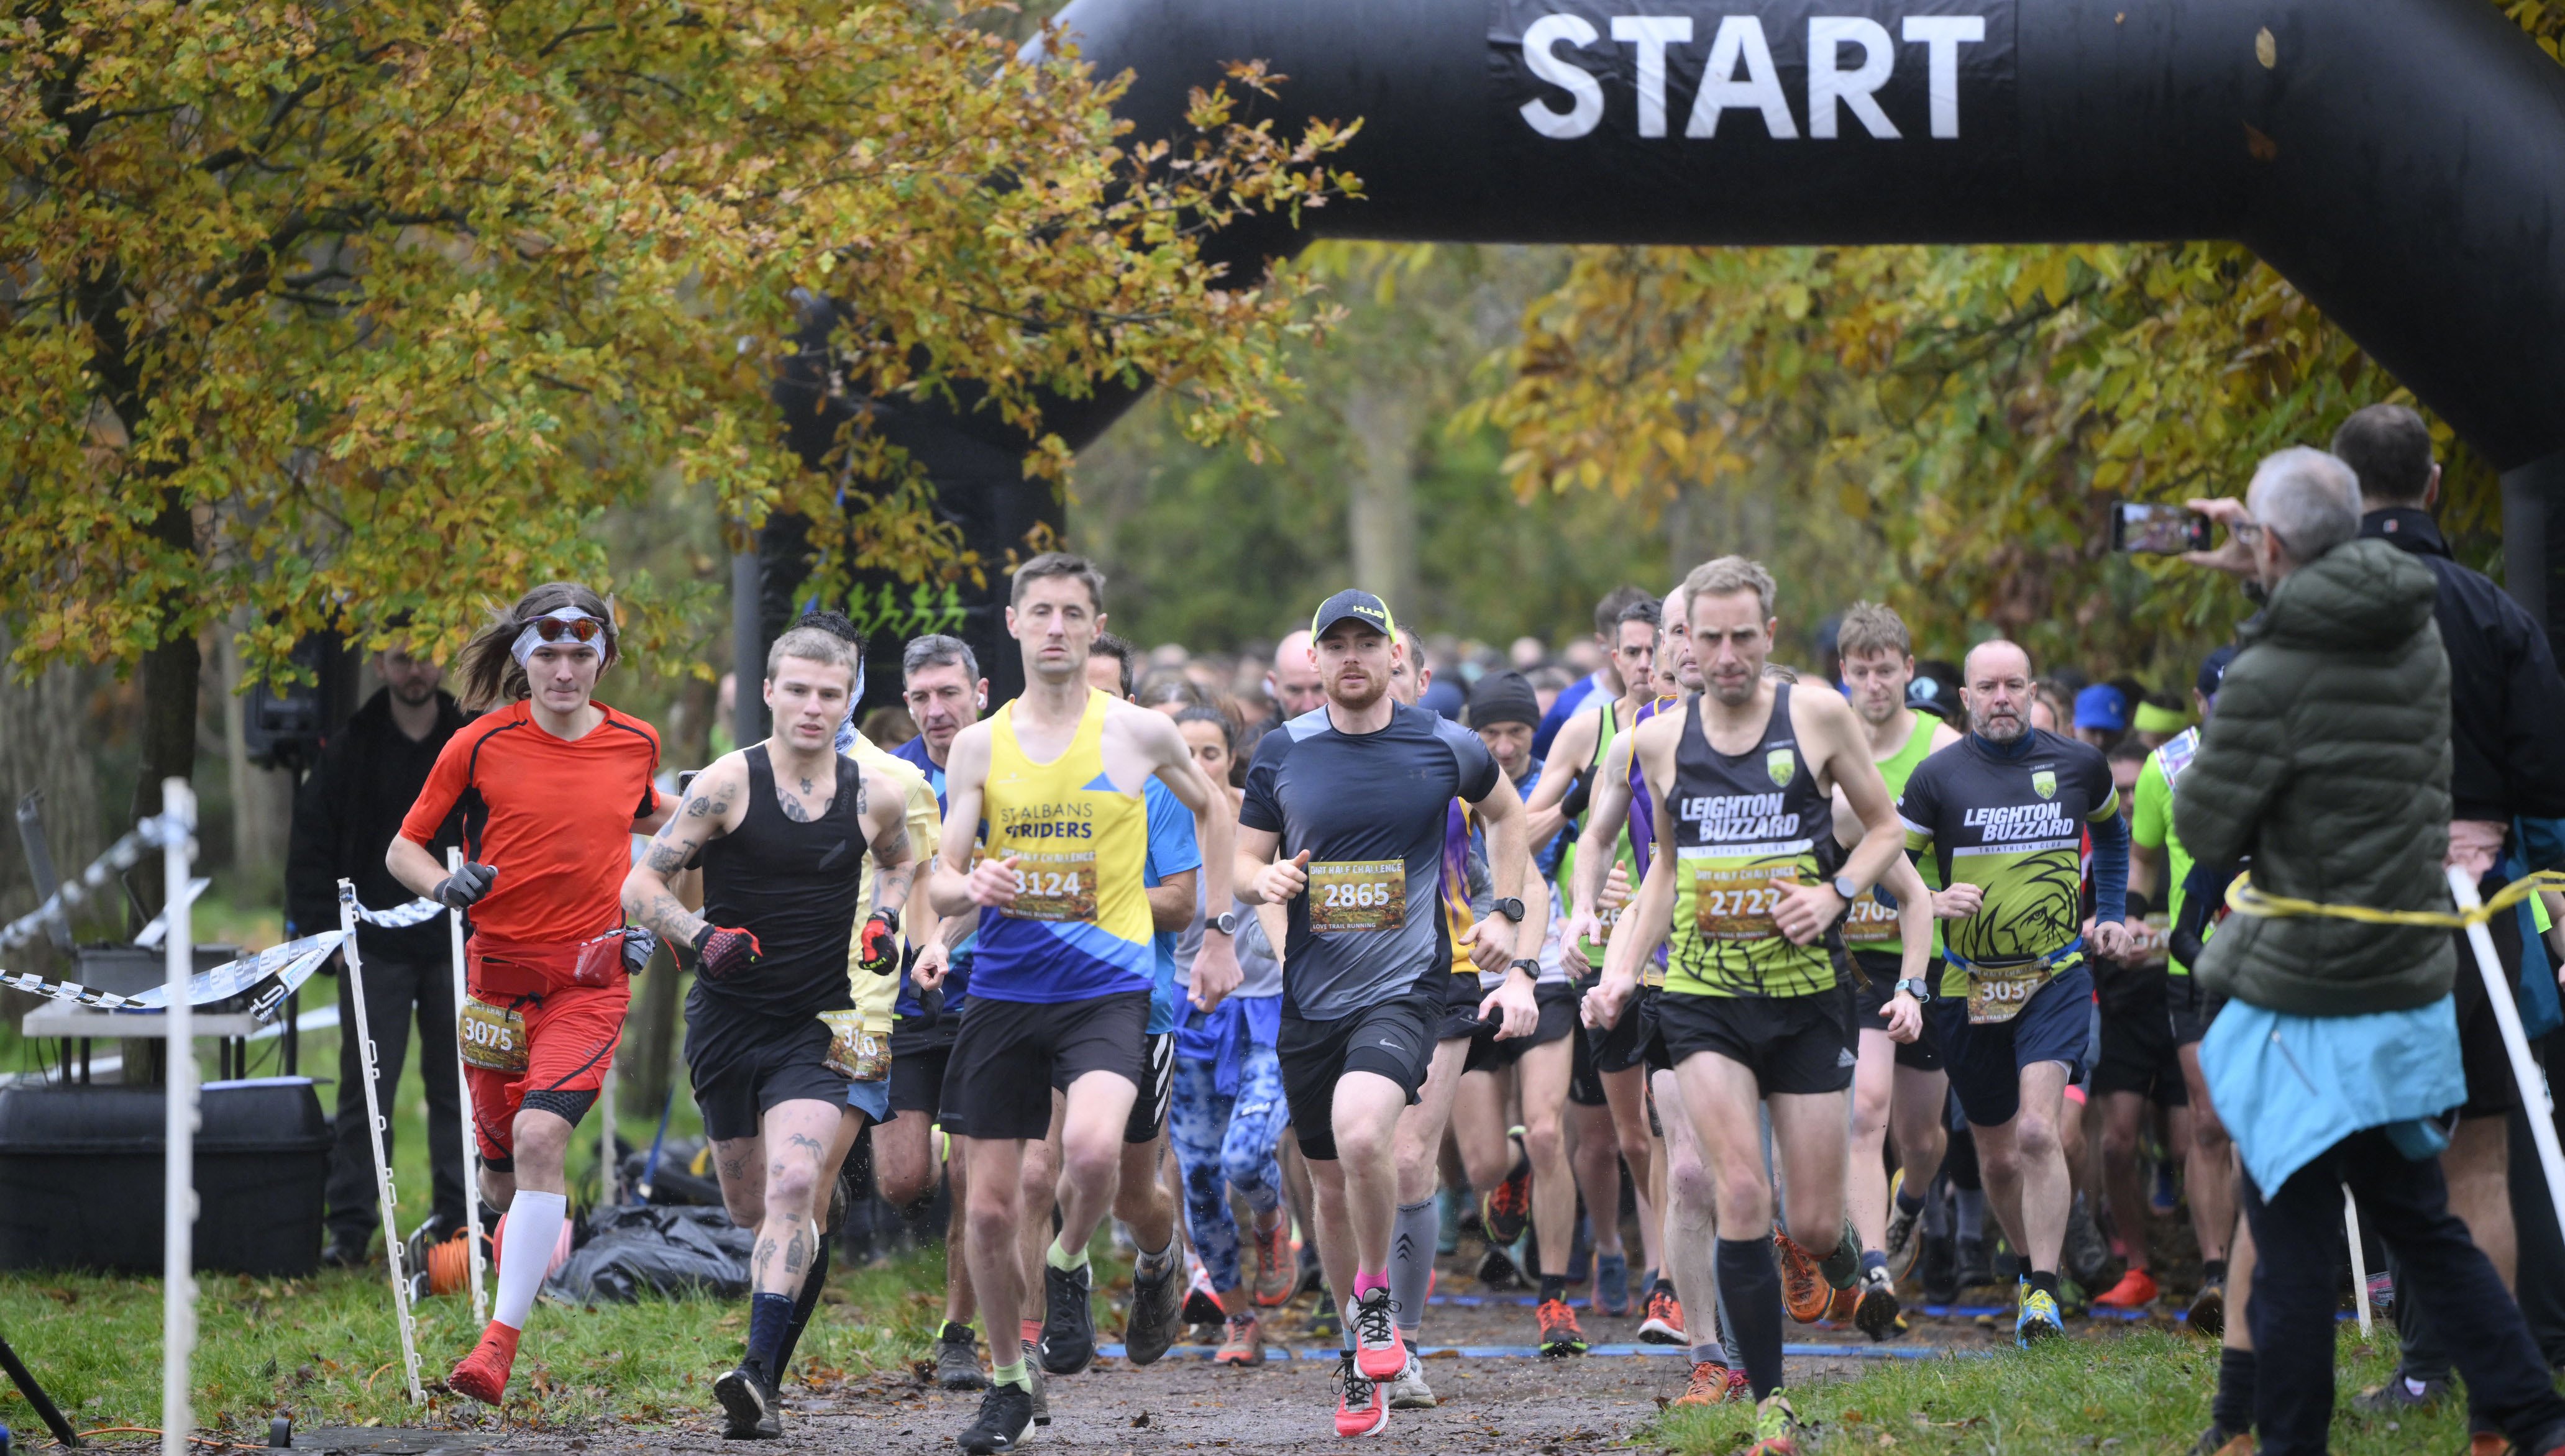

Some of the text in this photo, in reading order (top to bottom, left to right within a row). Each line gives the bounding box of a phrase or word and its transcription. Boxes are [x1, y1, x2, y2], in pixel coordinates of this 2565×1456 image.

[1520, 14, 1985, 139] START
[1353, 605, 1384, 619] HUUB
[1001, 803, 1093, 822] ST ALBANS
[1681, 792, 1785, 822] LEIGHTON
[1964, 802, 2062, 827] LEIGHTON
[1699, 812, 1800, 842] BUZZARD
[1982, 817, 2074, 842] BUZZARD
[1040, 851, 1095, 863] CHALLENGE
[1978, 840, 2062, 854] TRIATHLON CLUB
[1310, 863, 1402, 875] DIRT HALF CHALLENGE
[1740, 866, 1795, 880] CHALLENGE
[1013, 869, 1081, 896] 3124
[1324, 883, 1389, 907] 2865
[1710, 888, 1781, 916] 2727
[487, 1006, 524, 1022] CHALLNGE
[465, 1017, 513, 1051] 3075
[466, 1055, 477, 1065] TRAIL
[478, 1059, 504, 1069] RUNNING
